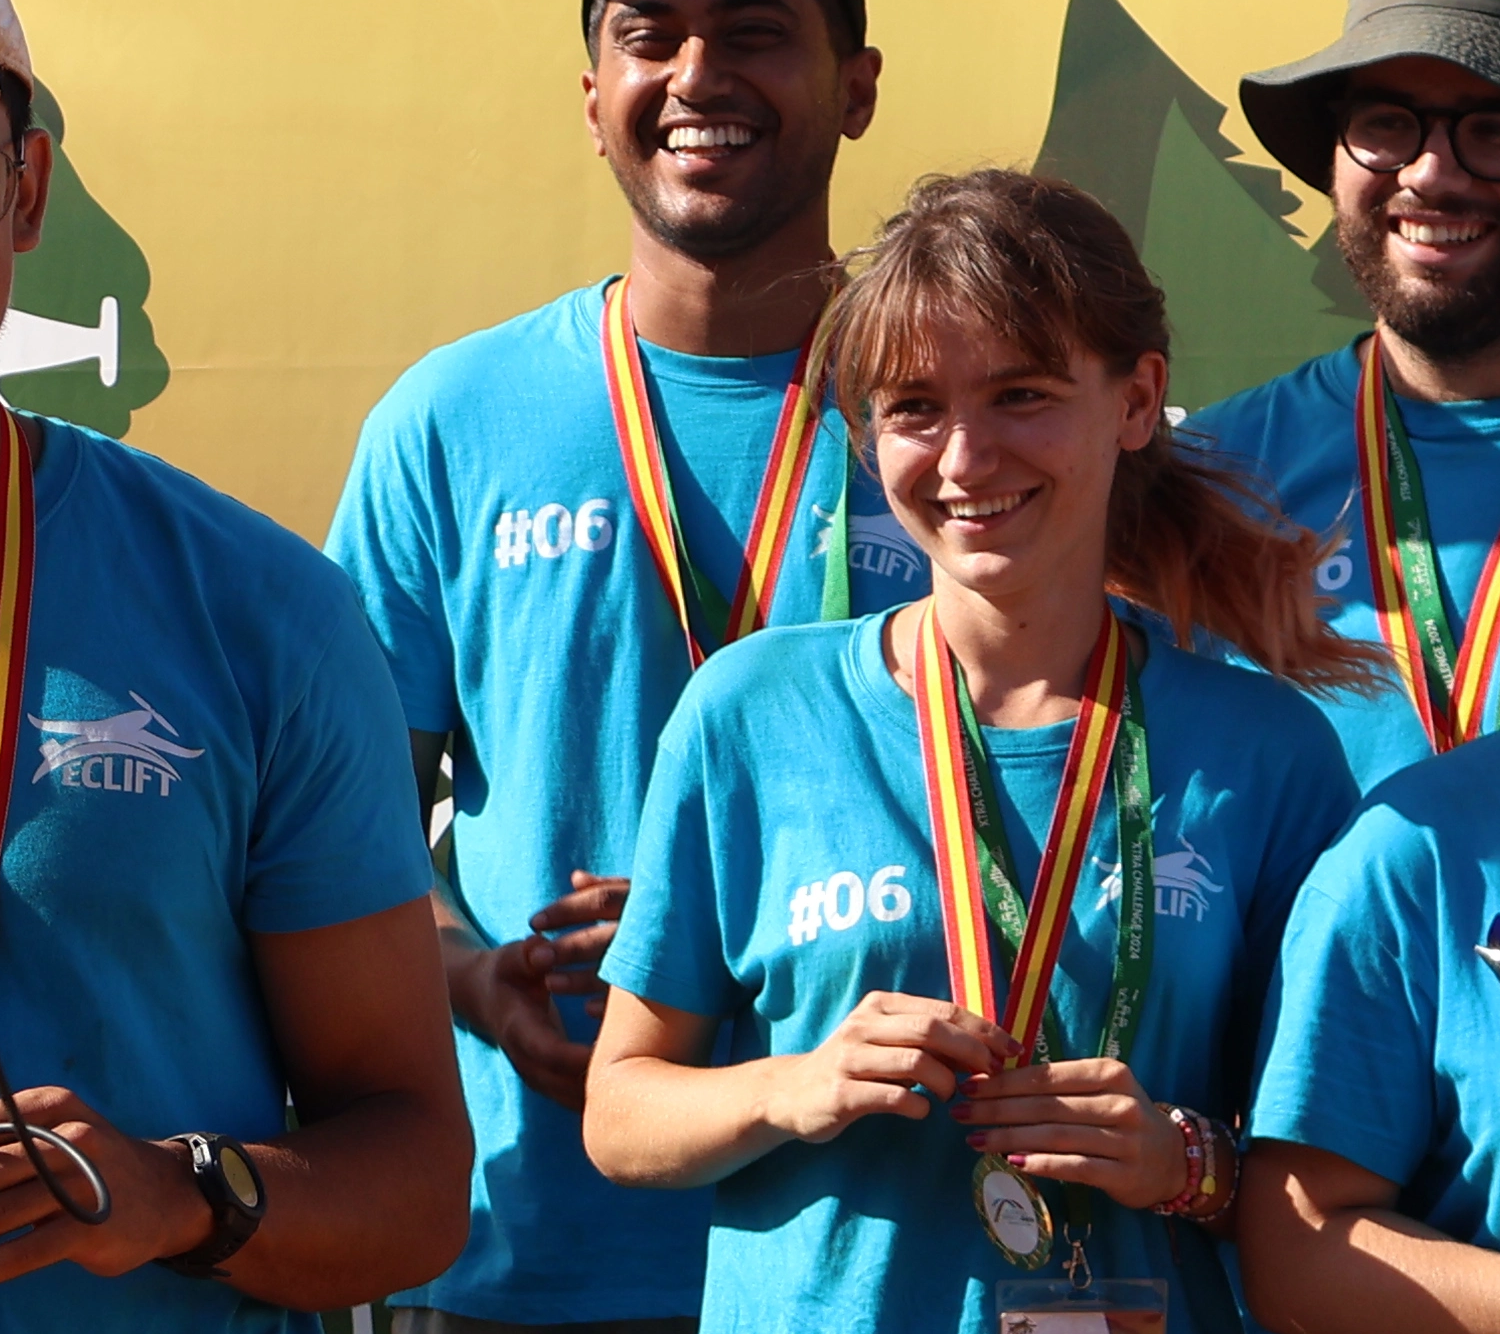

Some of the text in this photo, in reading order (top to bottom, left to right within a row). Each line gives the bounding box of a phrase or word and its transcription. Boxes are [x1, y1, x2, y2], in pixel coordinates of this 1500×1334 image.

[494, 497, 613, 569] #06
[847, 542, 918, 583] CLIFT
[61, 756, 171, 797] ECLIFT
[787, 864, 912, 946] #06
